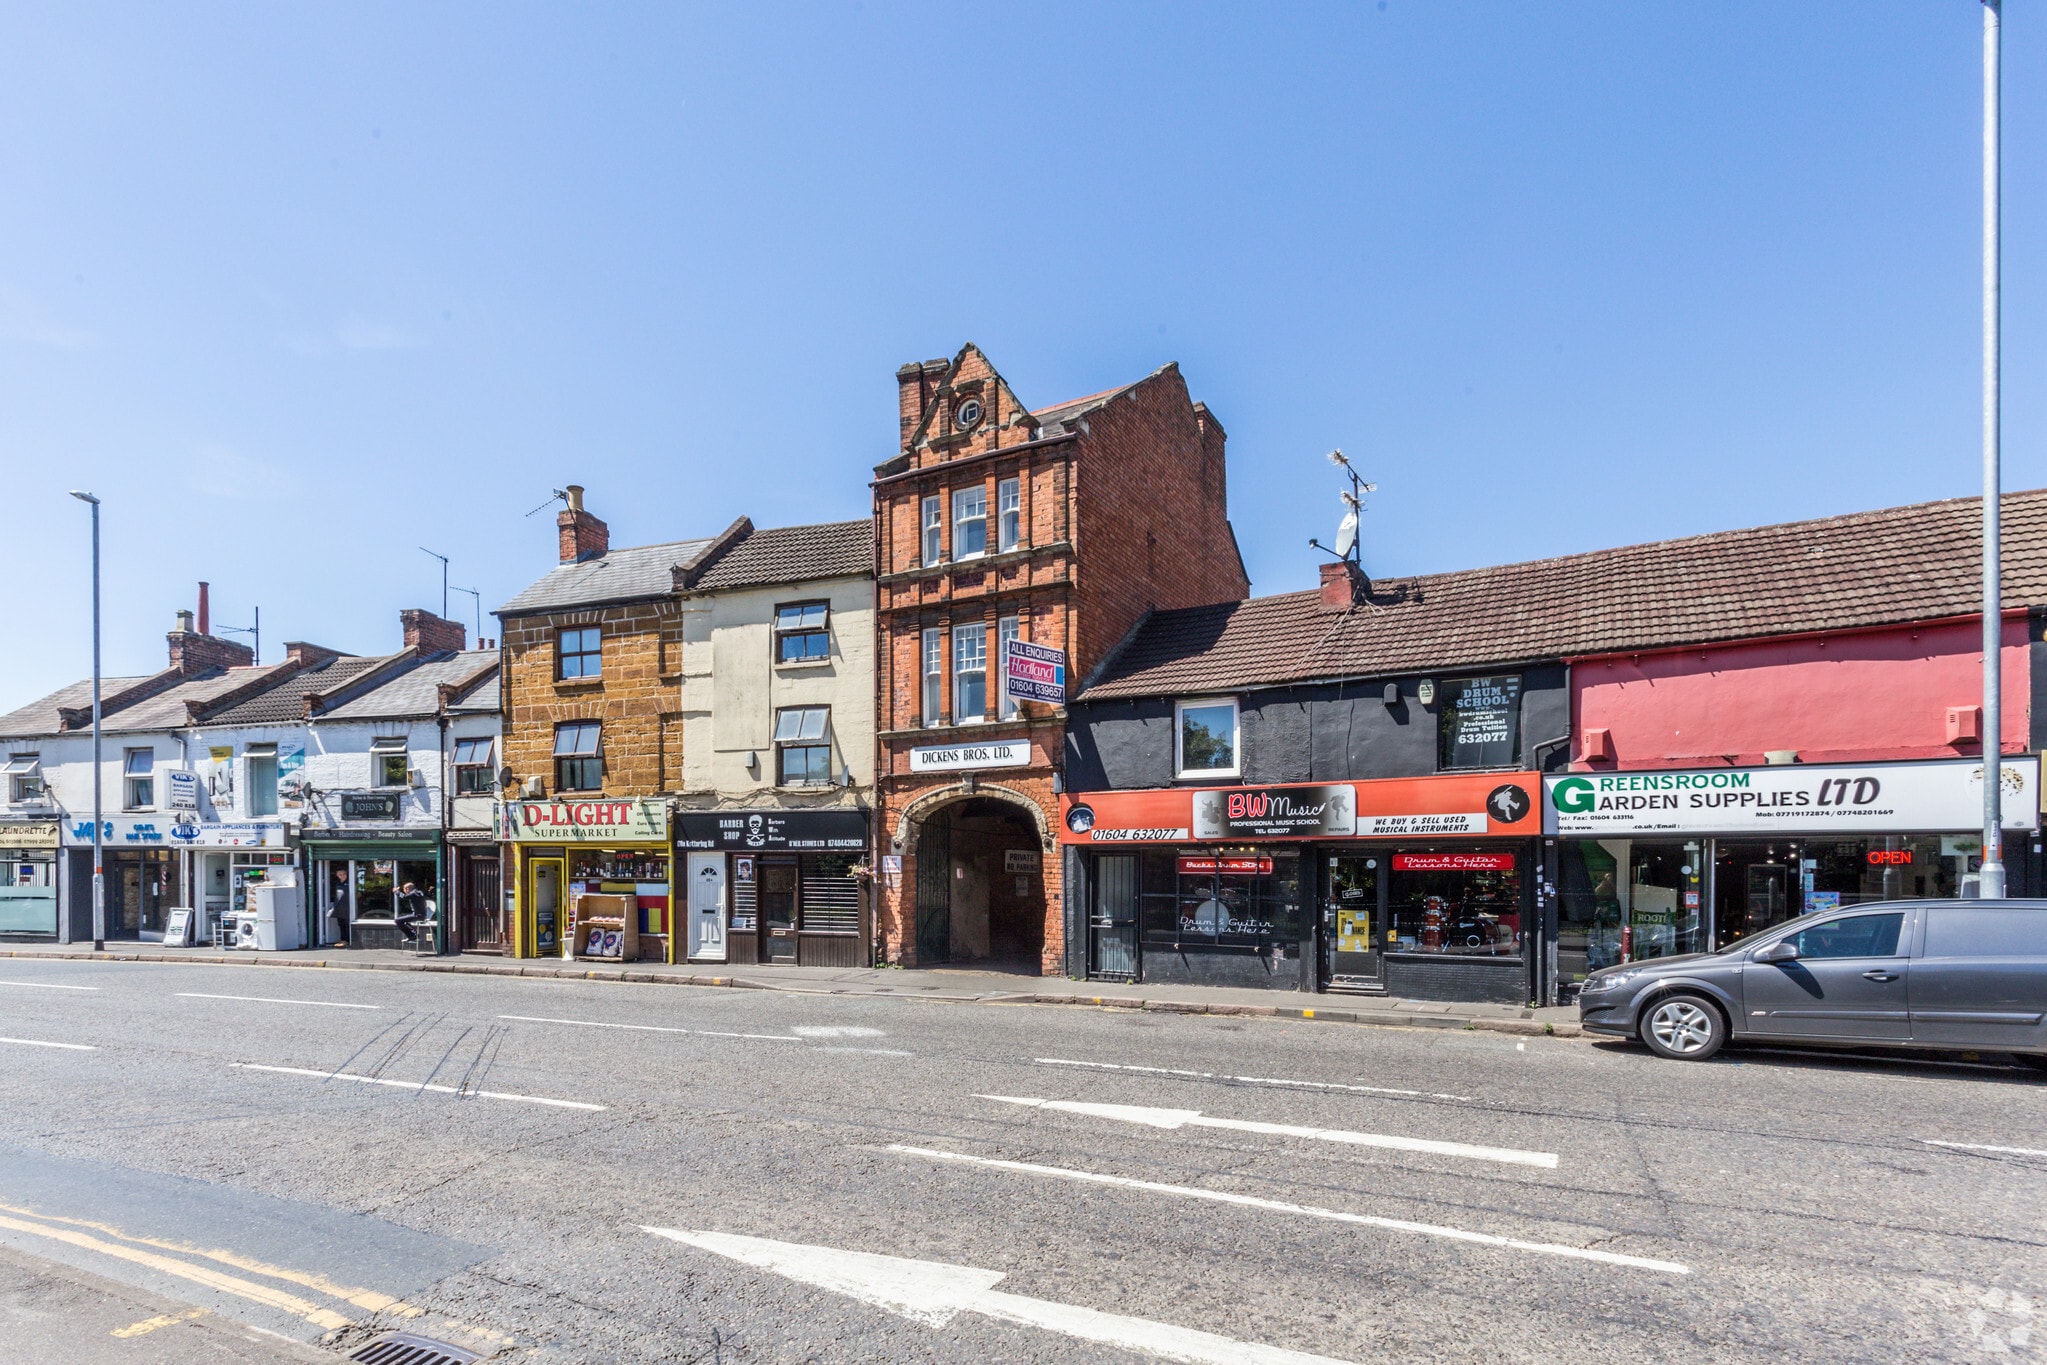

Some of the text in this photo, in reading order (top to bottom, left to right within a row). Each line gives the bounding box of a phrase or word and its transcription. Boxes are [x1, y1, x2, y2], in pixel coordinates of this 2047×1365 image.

[1011, 643, 1063, 663] ALL ENQUIRIES
[1011, 656, 1054, 678] Hadland
[1010, 679, 1062, 698] 01604 639657
[1472, 678, 1491, 688] BW
[1463, 687, 1501, 698] DRUM
[1457, 695, 1510, 708] SCHOOL
[1482, 723, 1508, 731] Tuition
[1458, 731, 1508, 744] 632077
[922, 746, 1013, 764] DICKENS BROS. LTD.
[1690, 791, 1810, 808] SUPPLIES
[1816, 776, 1881, 806] LTD
[1228, 792, 1267, 819] BW
[522, 803, 633, 827] D-LIGHT
[1775, 809, 1830, 817] 07719172874
[1836, 808, 1894, 816] 07748201669
[719, 819, 744, 829] BARBER
[1229, 820, 1275, 828] PROFESSIONAL
[1297, 818, 1321, 826] SCHOOL
[1375, 818, 1387, 826] WE
[1391, 817, 1407, 825] BUY
[1420, 816, 1440, 825] SELL
[1443, 815, 1467, 823] USED
[174, 824, 198, 837] VIK'S
[535, 828, 618, 838] SUPERMARKET
[1092, 828, 1179, 840] 01604 632077
[1372, 823, 1470, 834] MUSICAL INSTRUMENTS
[378, 830, 396, 839] Beauty
[398, 830, 413, 838] Salon
[723, 831, 740, 840] SHOP
[1009, 852, 1035, 862] PRIVATE
[1404, 856, 1441, 864] Drum
[1867, 851, 1912, 864] OPEN
[1462, 861, 1497, 869] Here
[1179, 916, 1215, 926] Drum
